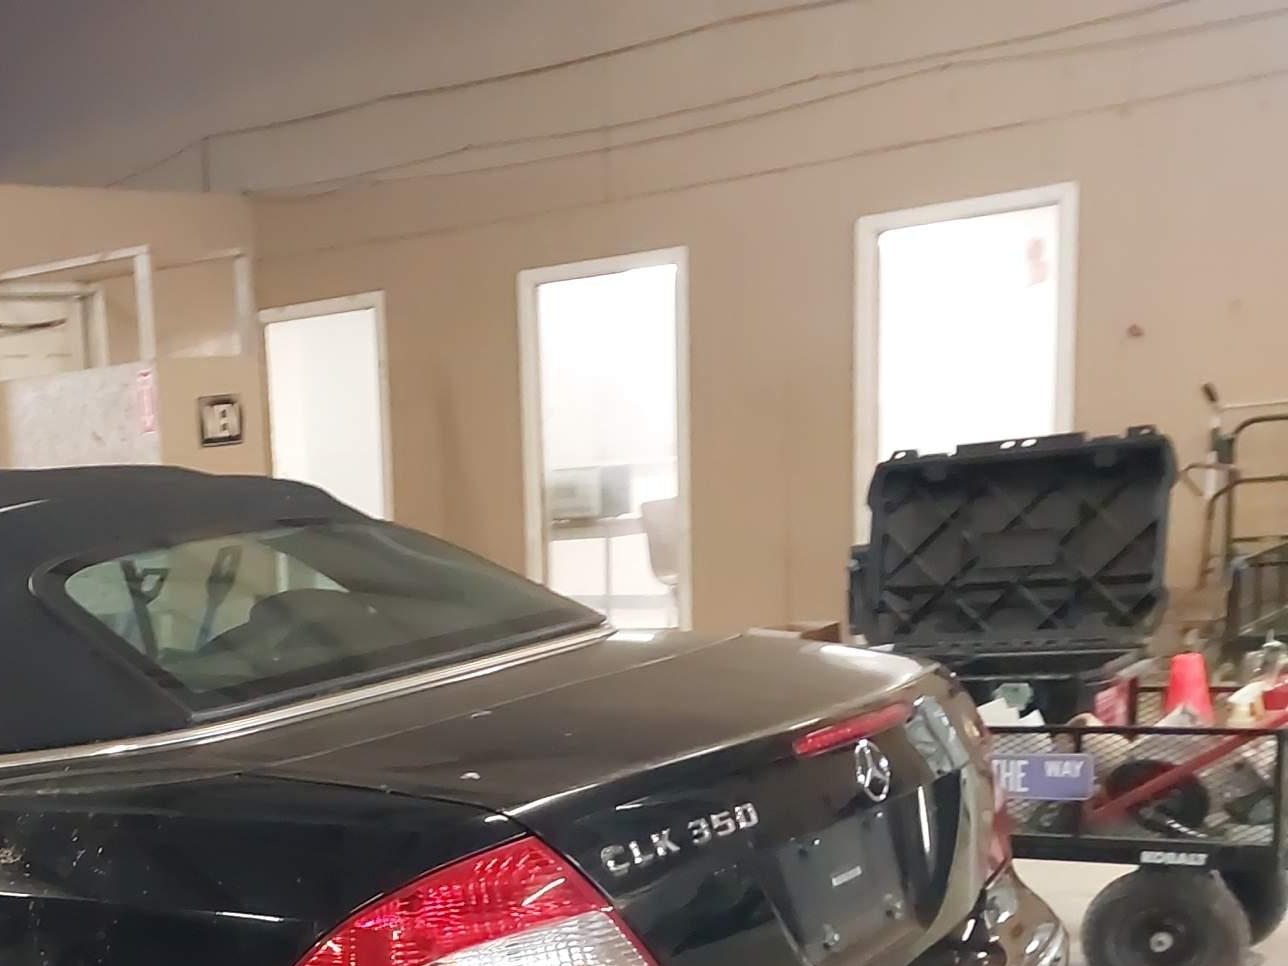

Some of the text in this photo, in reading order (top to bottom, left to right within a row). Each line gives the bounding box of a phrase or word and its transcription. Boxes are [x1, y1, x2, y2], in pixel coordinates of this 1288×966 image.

[1044, 760, 1085, 778] WAY
[600, 802, 759, 876] CLK 350
